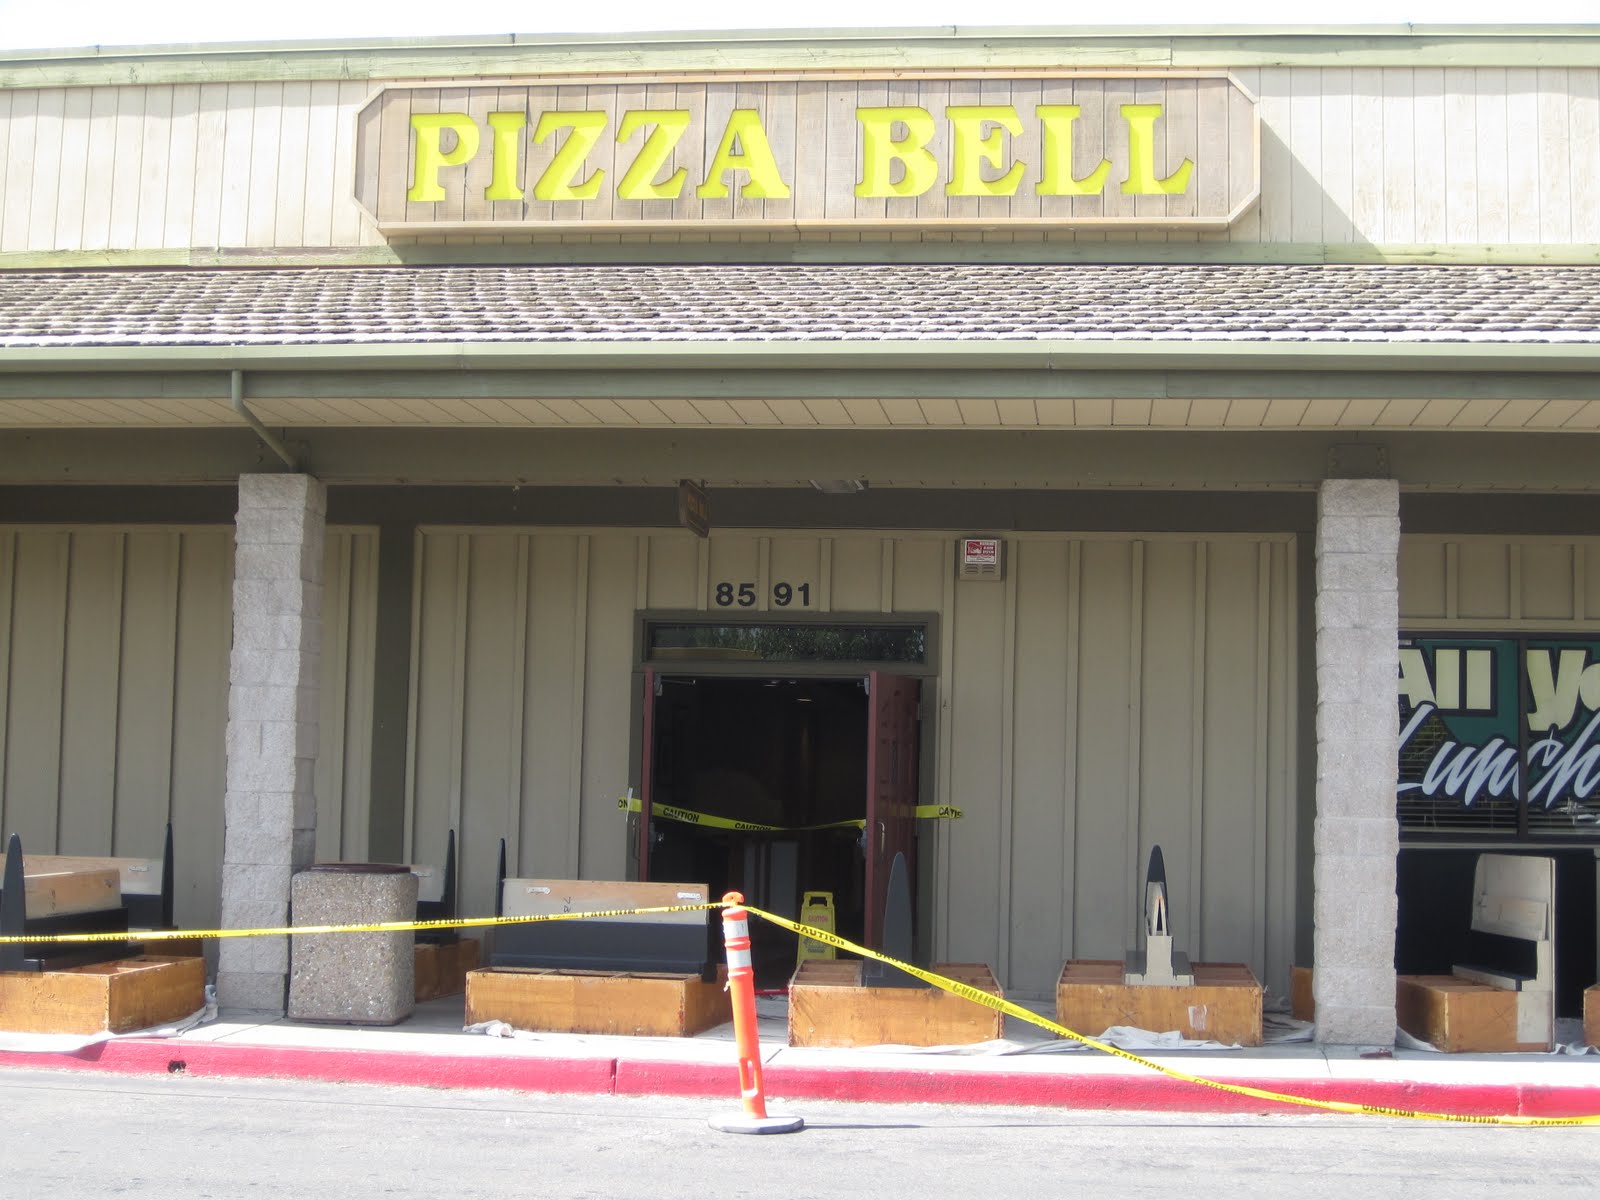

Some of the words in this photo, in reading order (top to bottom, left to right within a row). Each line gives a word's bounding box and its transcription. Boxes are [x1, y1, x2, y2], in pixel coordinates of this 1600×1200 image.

[407, 108, 791, 203] PIZZA
[854, 103, 1195, 198] BELL
[663, 807, 700, 823] CAUTION
[793, 923, 845, 946] CAUTION
[1112, 1050, 1164, 1073] CAUTION
